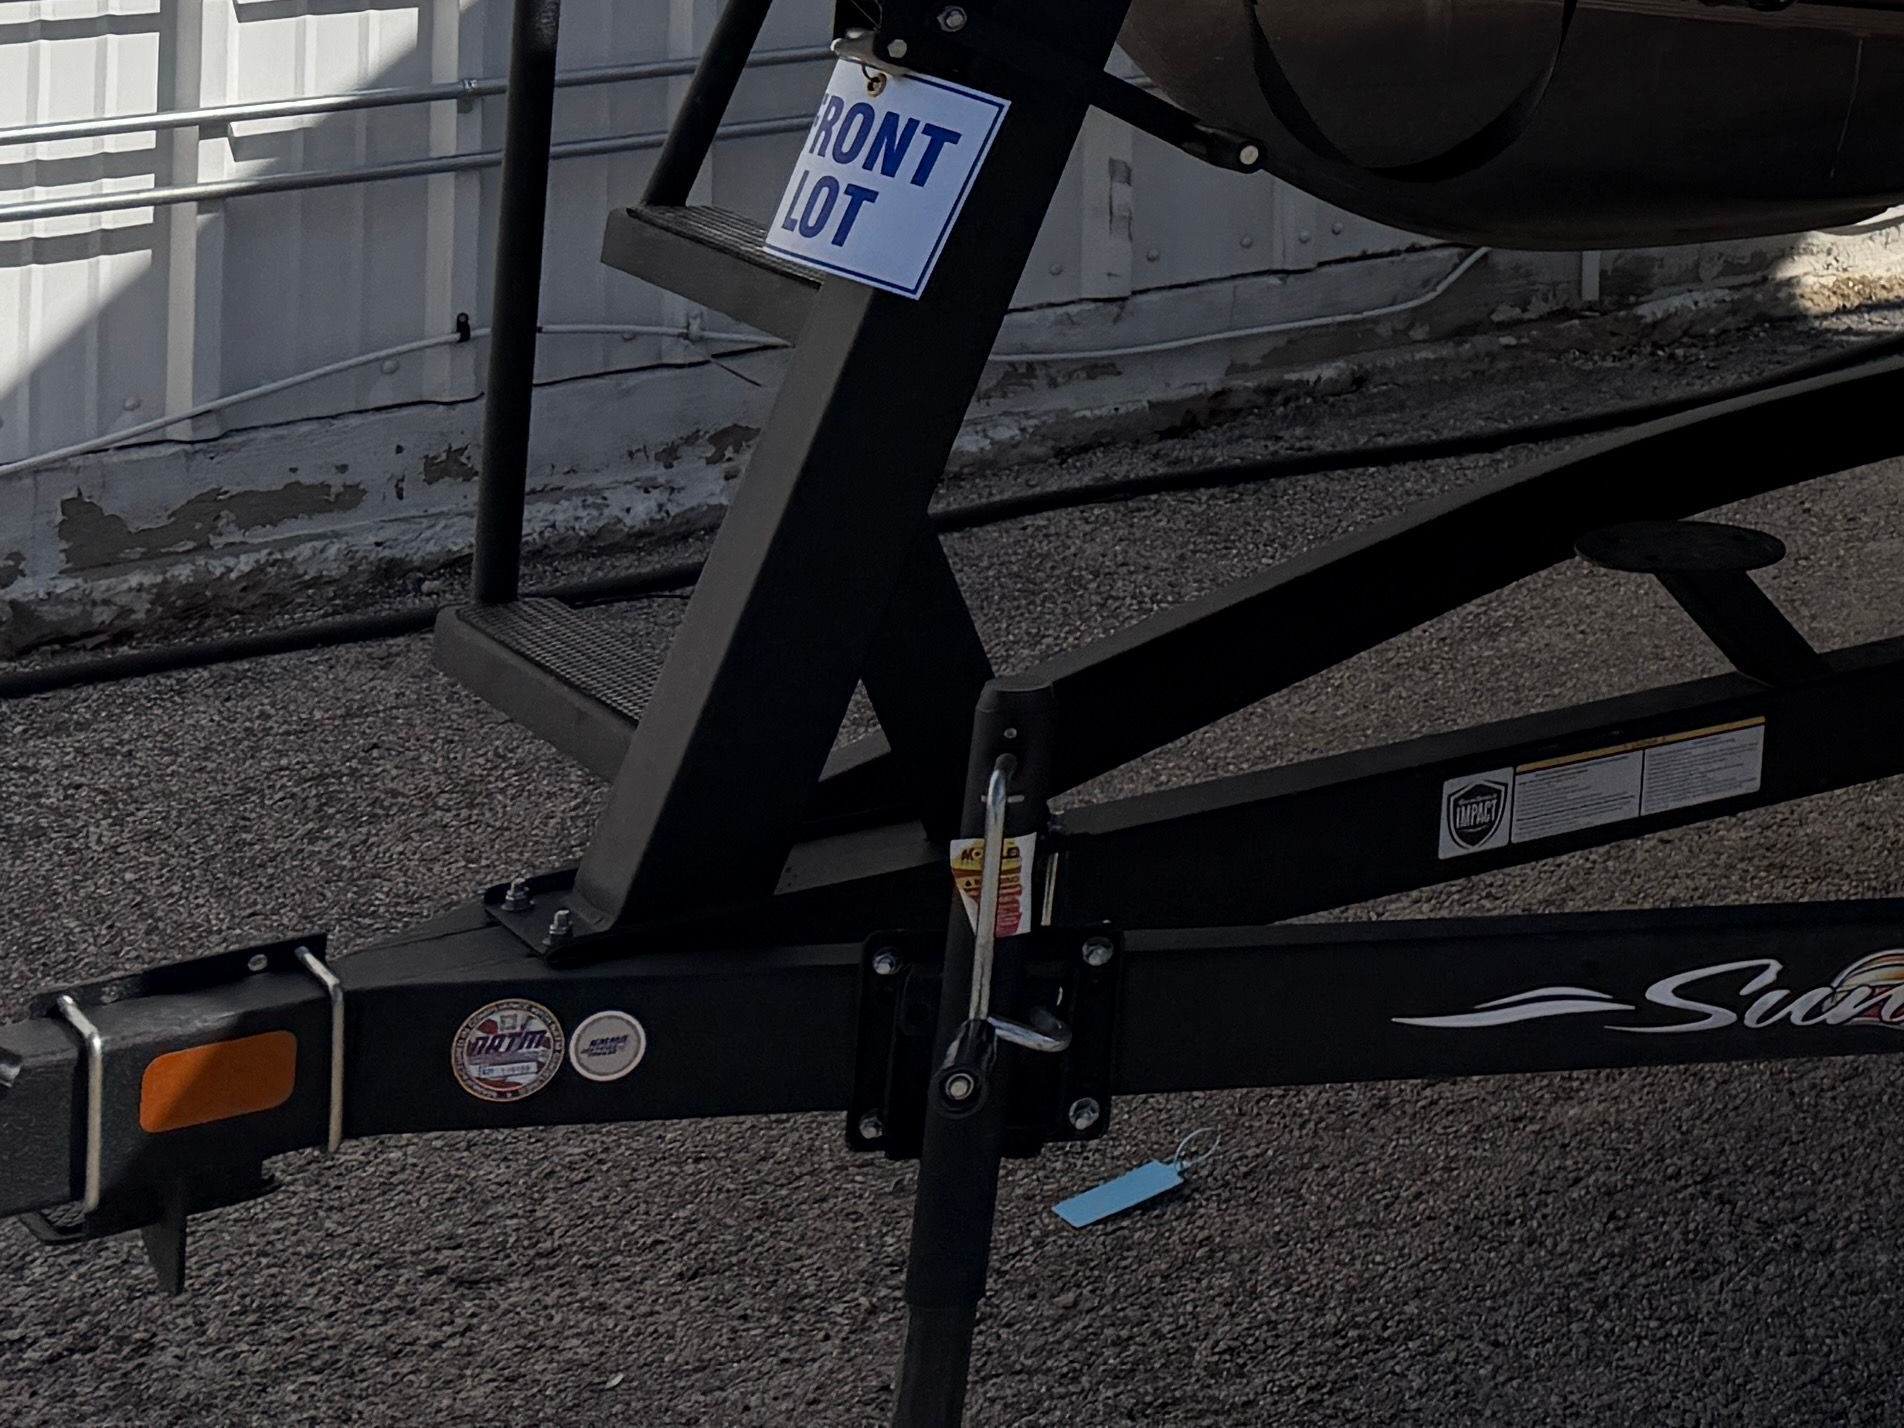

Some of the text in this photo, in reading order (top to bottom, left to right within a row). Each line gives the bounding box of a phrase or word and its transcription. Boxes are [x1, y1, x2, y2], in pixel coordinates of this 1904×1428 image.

[809, 93, 962, 187] RONT
[781, 169, 879, 247] LOT
[1456, 799, 1498, 829] IMPACT
